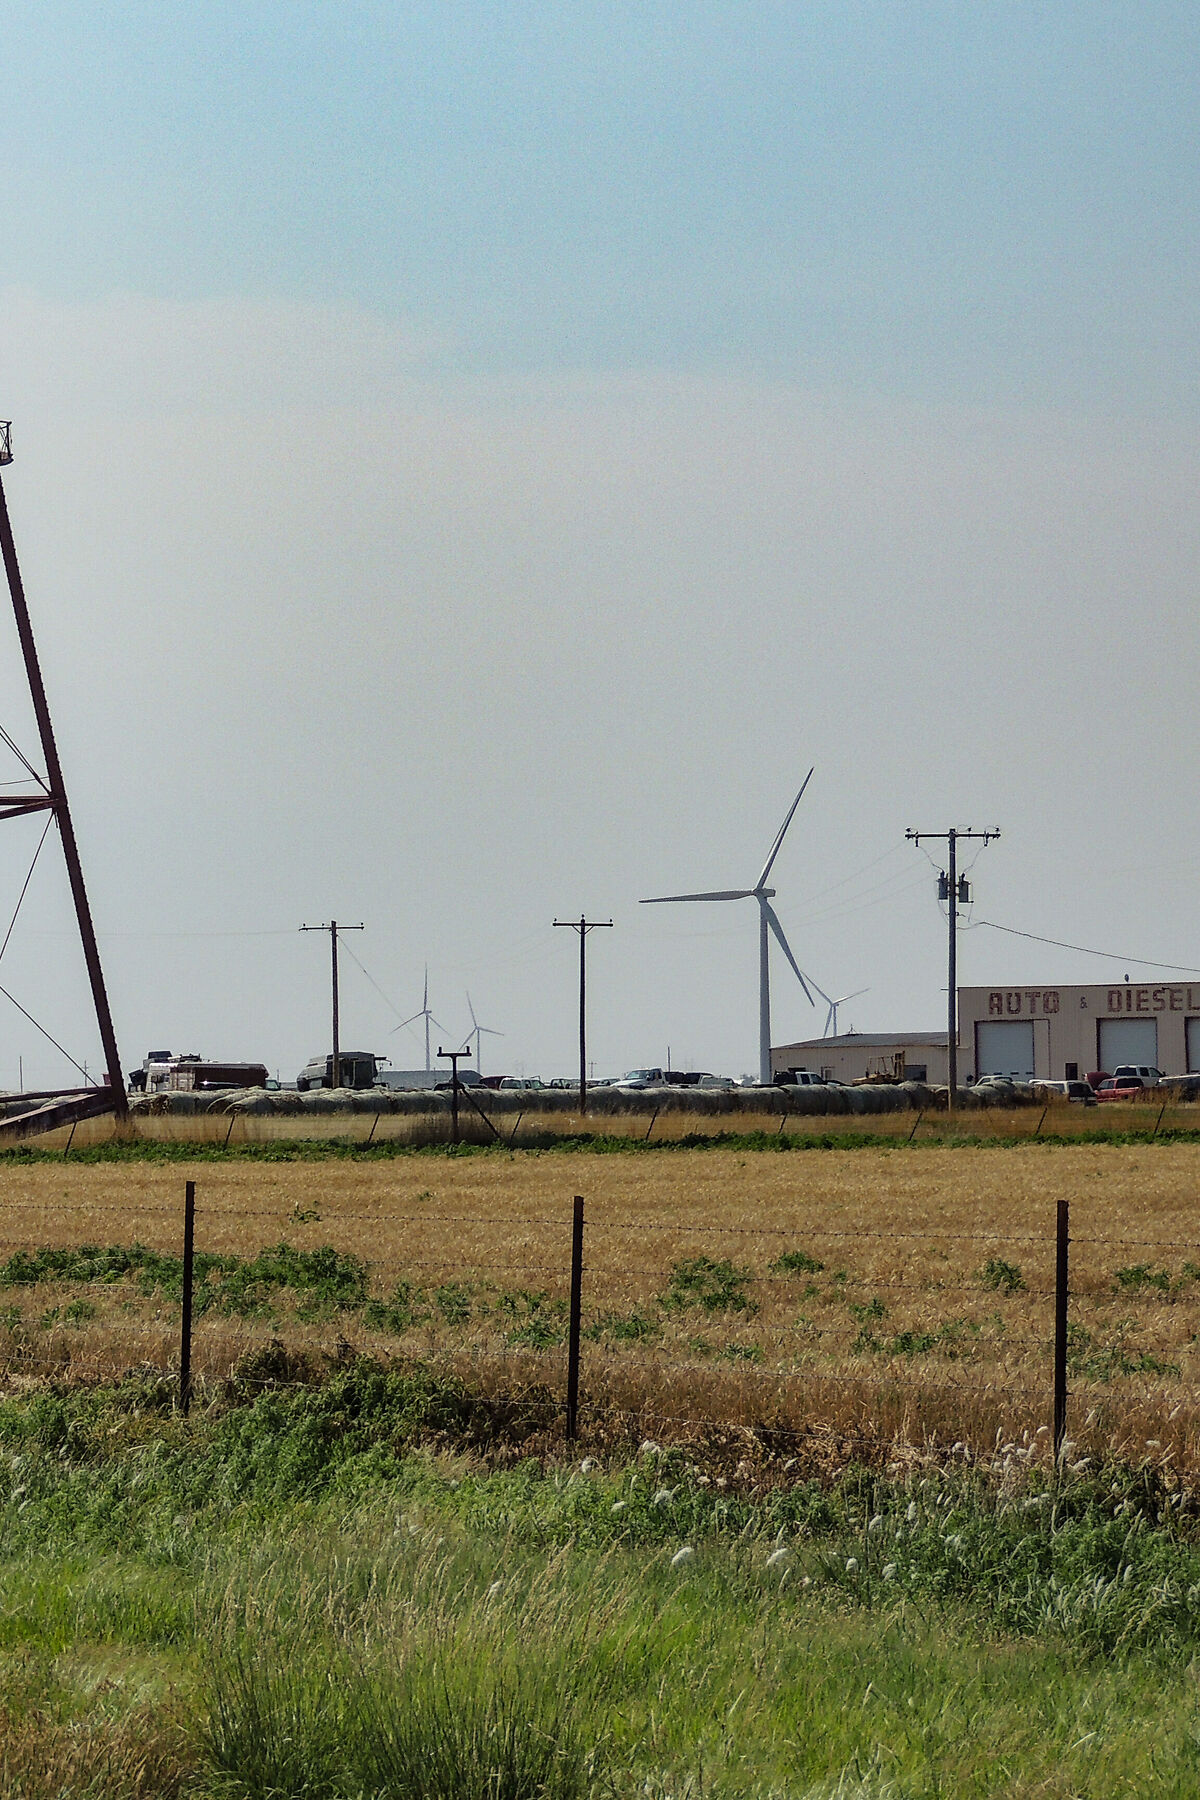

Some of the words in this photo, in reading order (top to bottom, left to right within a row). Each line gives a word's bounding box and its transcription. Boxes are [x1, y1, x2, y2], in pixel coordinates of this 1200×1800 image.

[988, 991, 1060, 1015] AUTO
[1079, 996, 1088, 1009] &
[1107, 988, 1200, 1012] DIESEL
